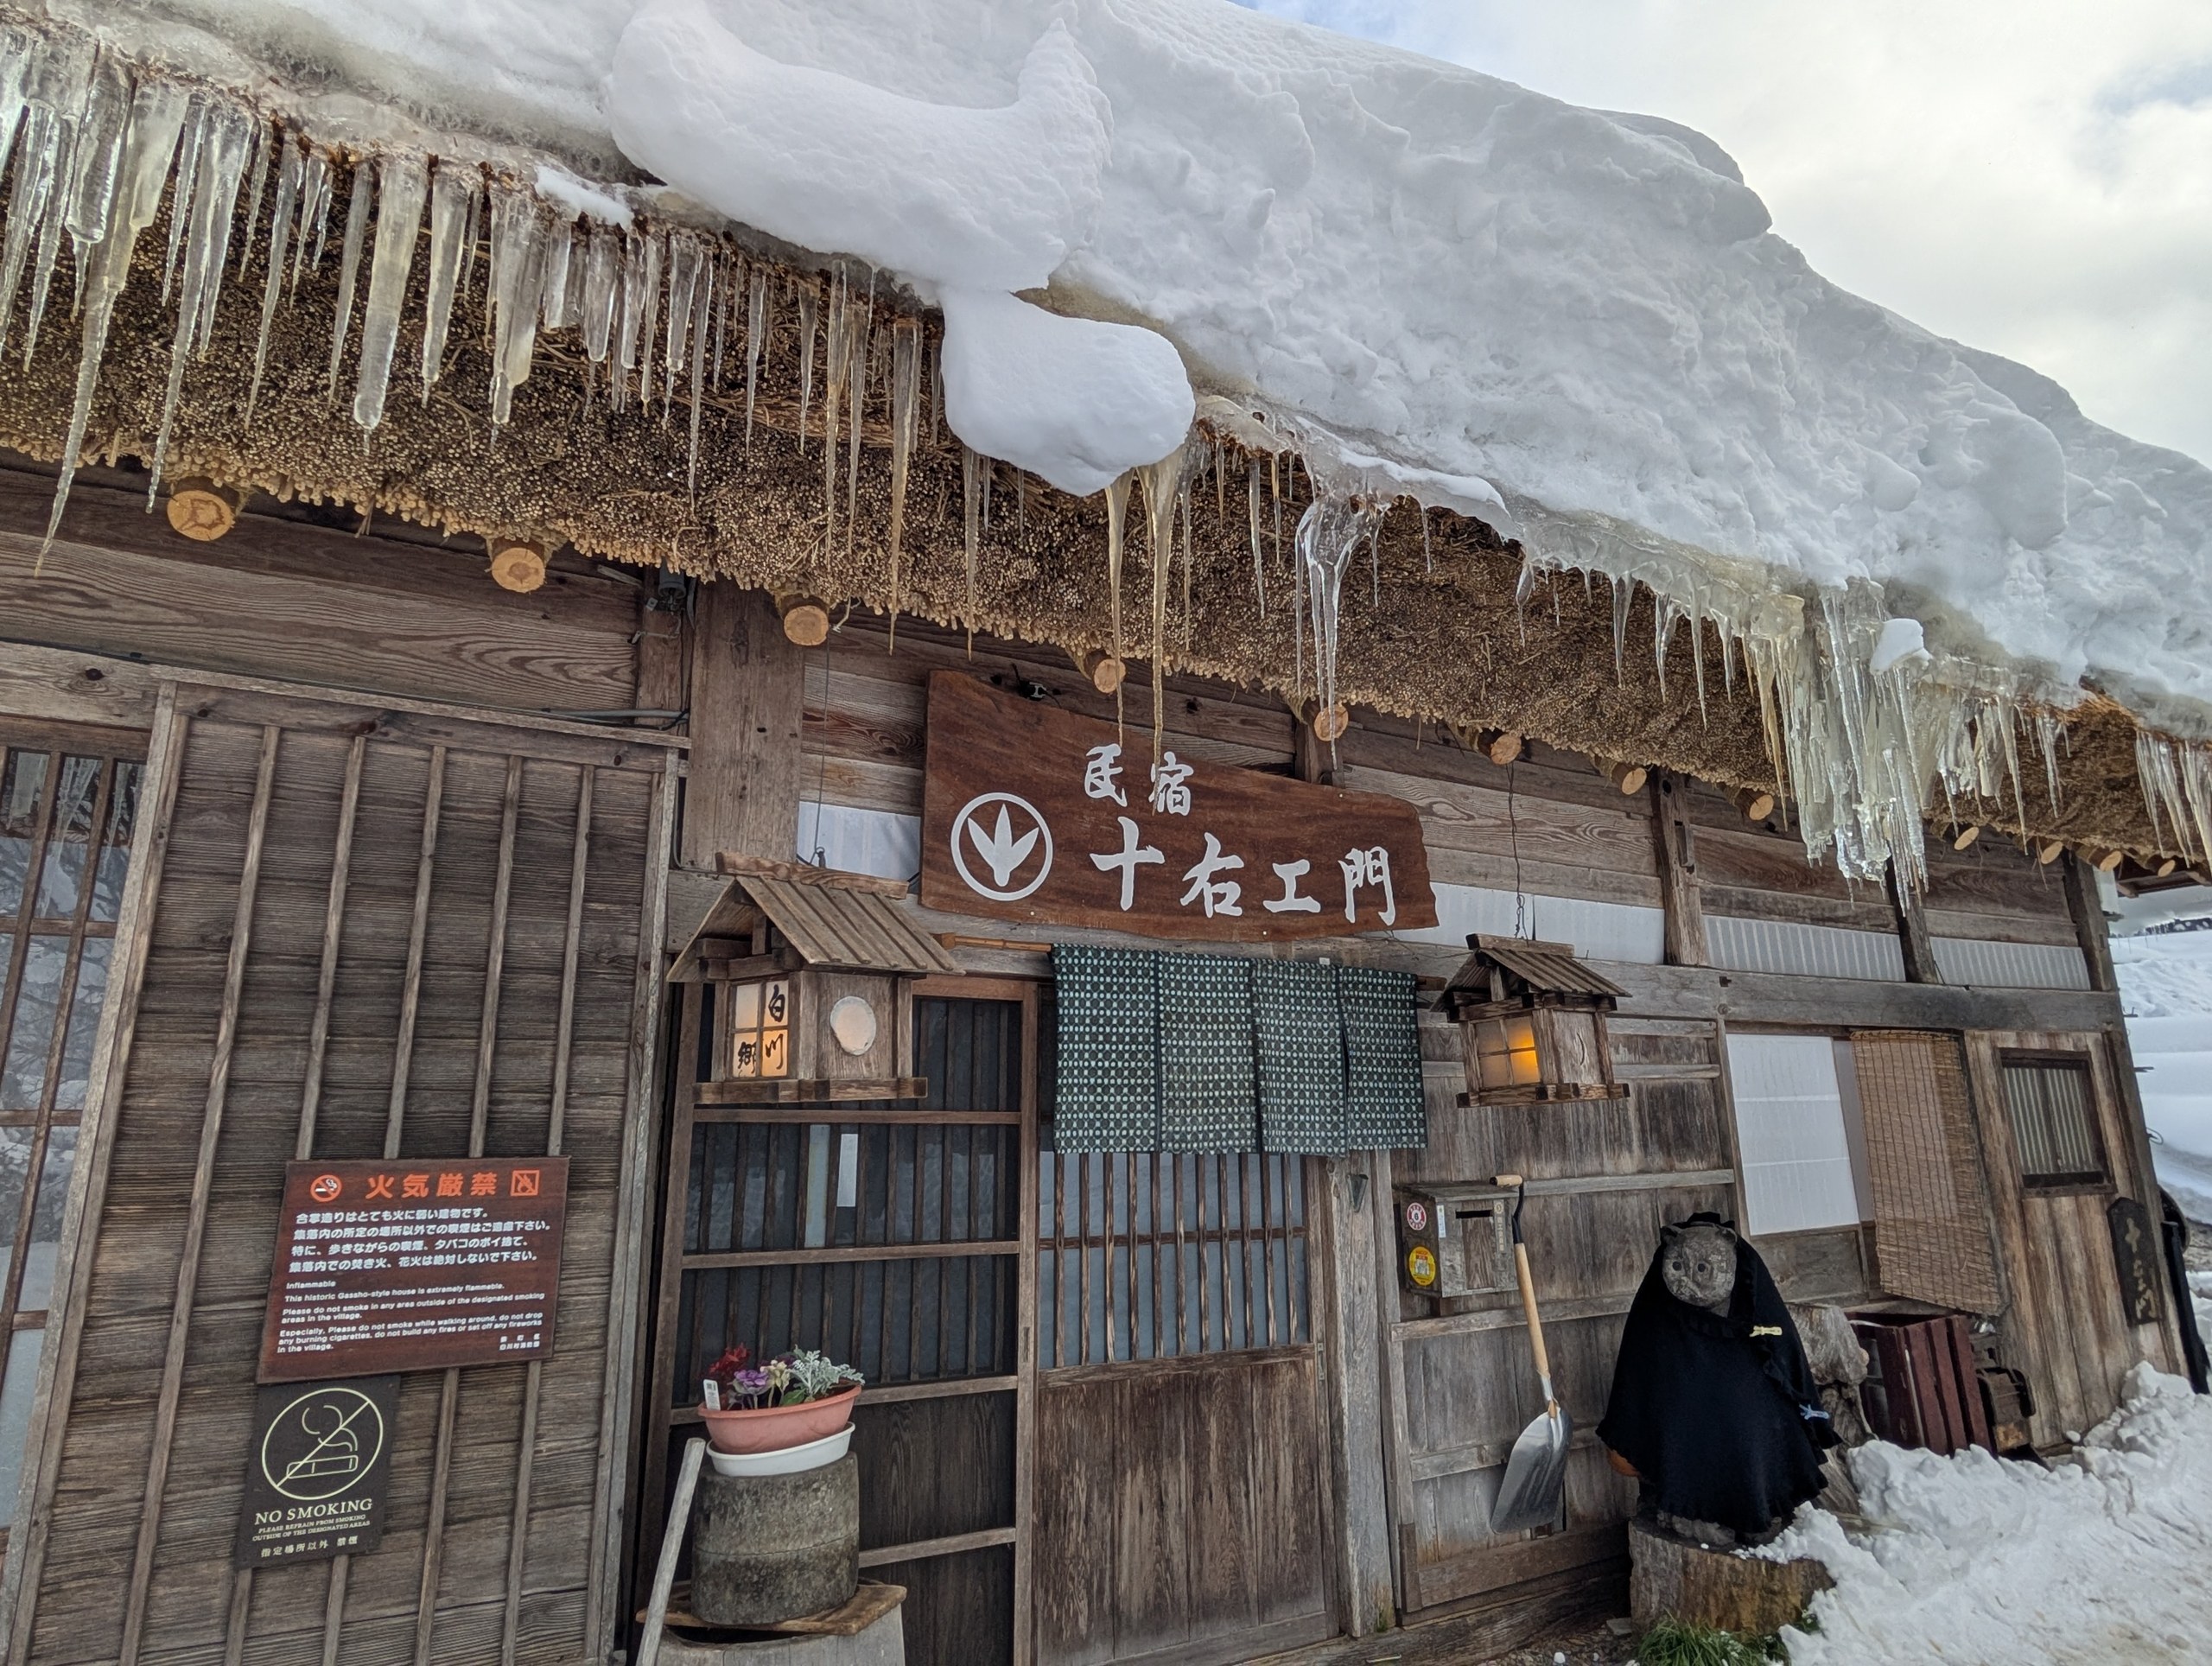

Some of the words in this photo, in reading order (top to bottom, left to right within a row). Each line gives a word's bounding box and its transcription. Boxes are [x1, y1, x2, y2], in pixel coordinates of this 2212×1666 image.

[1084, 743, 1194, 816] 民宿
[365, 1172, 498, 1199] 火気厳禁
[254, 1510, 282, 1525] NO
[287, 1498, 372, 1521] SMOKING
[258, 1525, 284, 1534] PLEASE
[285, 1522, 315, 1530] REFRAIN
[335, 1514, 366, 1523] SMOKING
[252, 1533, 282, 1542] OUTSIDE
[308, 1524, 349, 1535] DESIGNATED
[348, 1520, 371, 1529] AREAS
